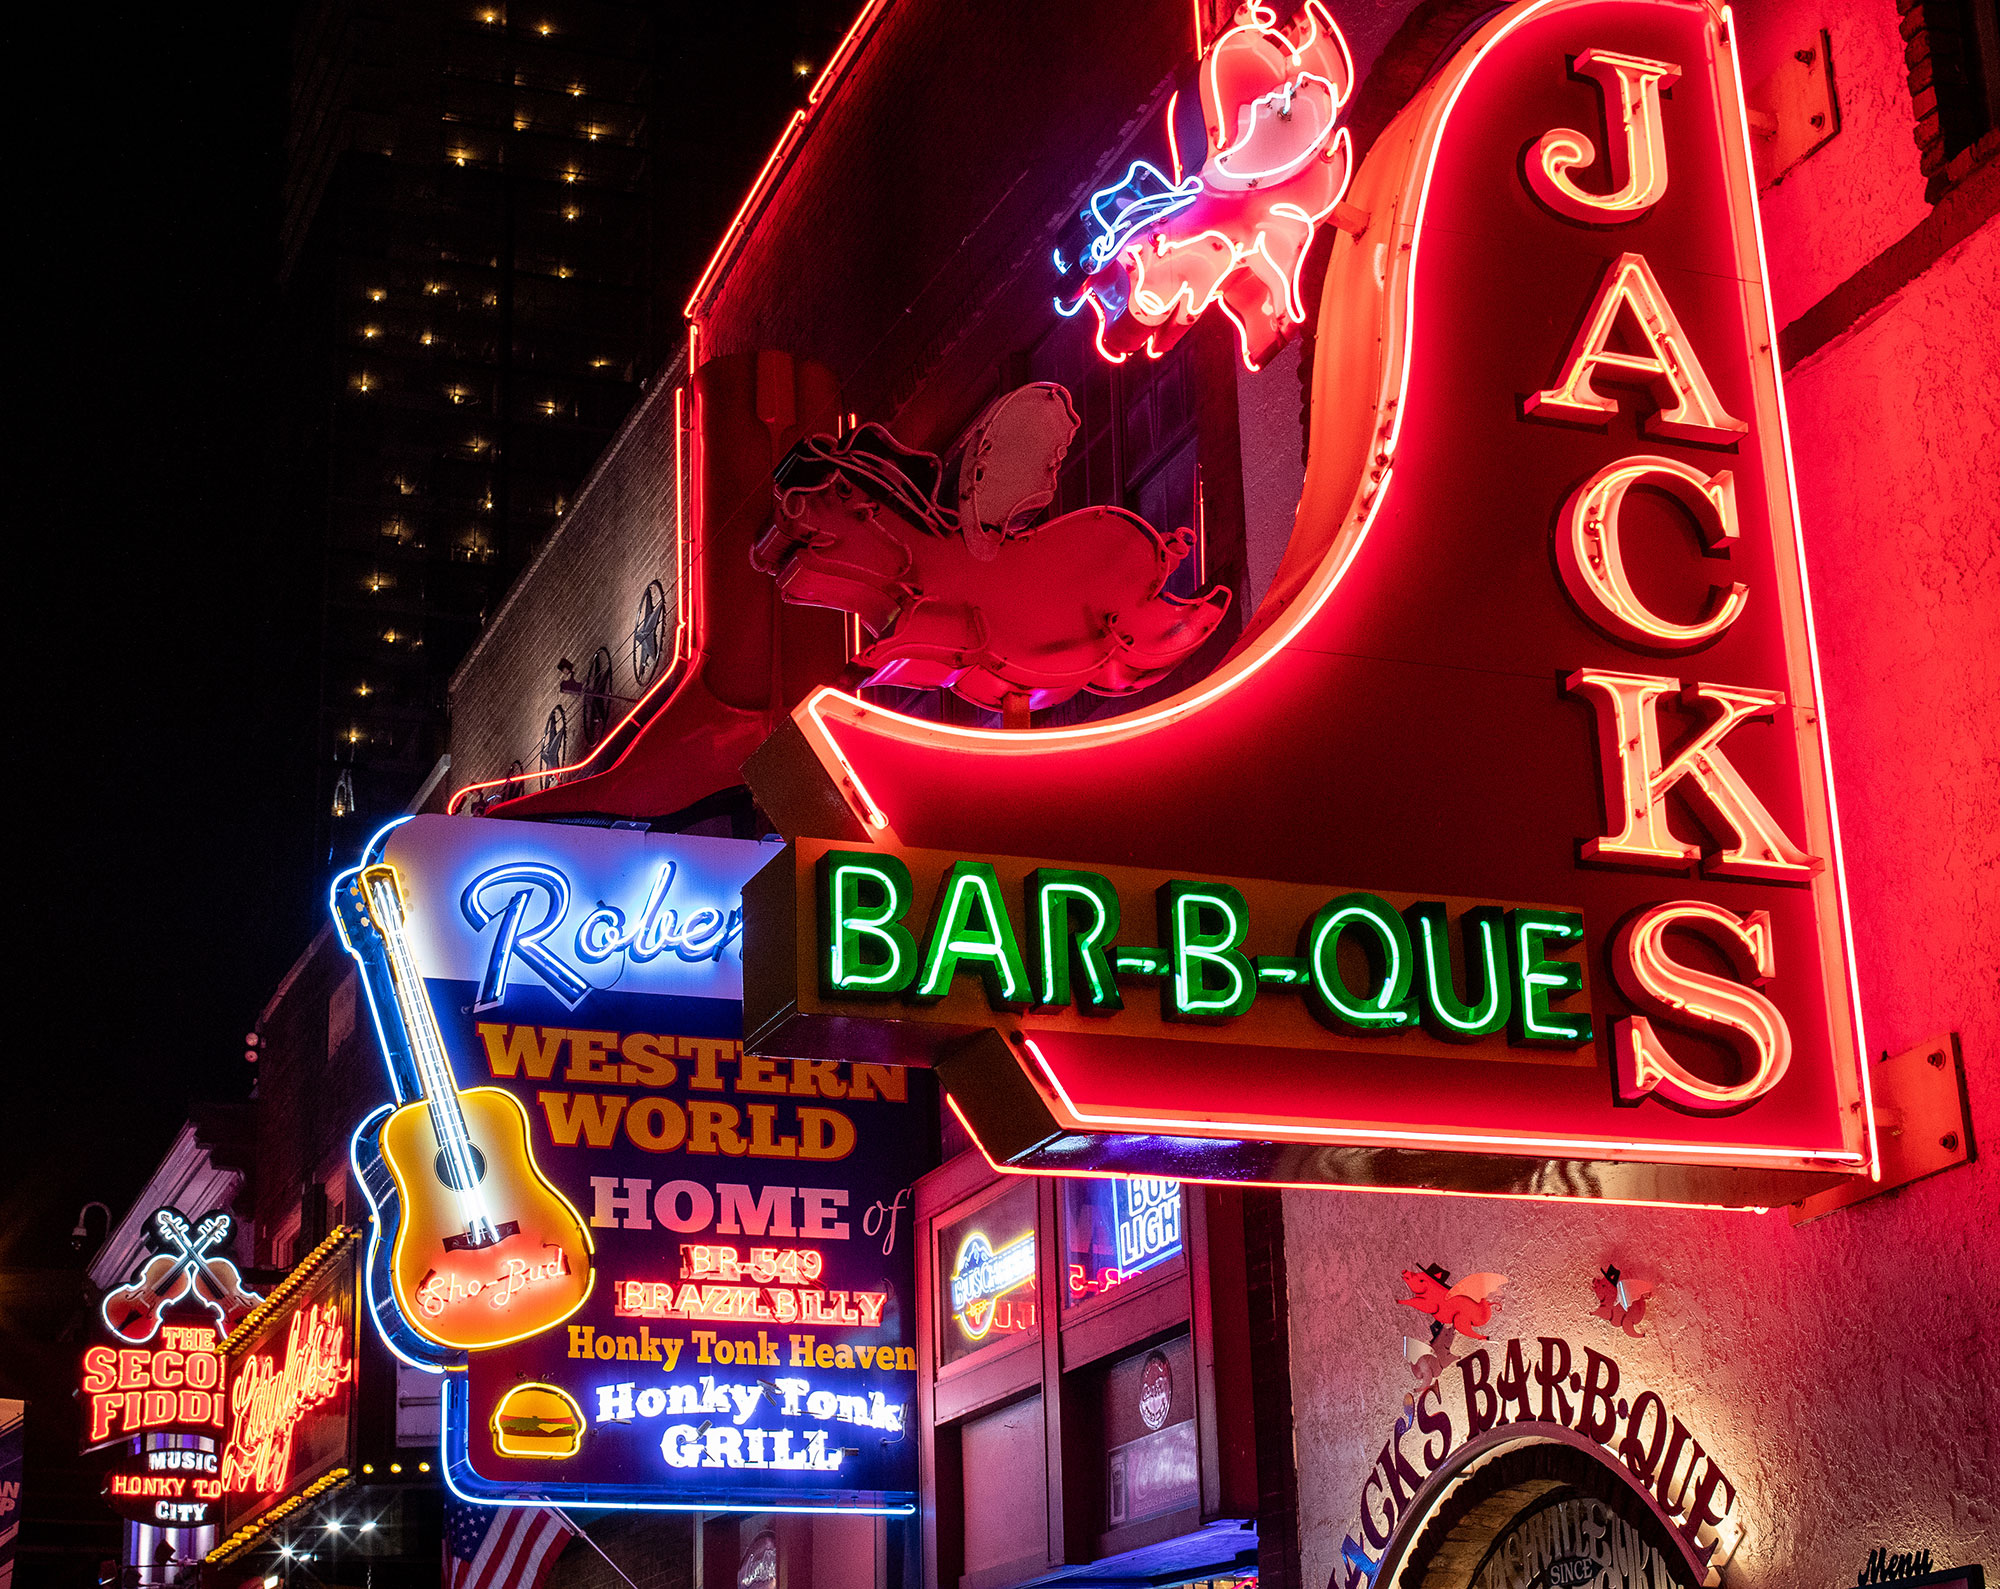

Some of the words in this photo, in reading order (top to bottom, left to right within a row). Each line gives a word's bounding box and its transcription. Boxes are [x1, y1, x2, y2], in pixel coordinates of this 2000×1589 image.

[1522, 46, 1828, 1112] JACKS
[460, 860, 744, 1012] Robe
[817, 847, 1596, 1050] BAR-B-QUE
[536, 1090, 858, 1162] WORLD
[589, 1175, 850, 1240] HOME
[862, 1188, 913, 1256] of
[420, 1246, 568, 1318] Sho-Bud
[680, 1244, 824, 1285] BR-549
[162, 1326, 216, 1351] THE
[567, 1325, 684, 1373] Honky
[691, 1330, 781, 1367] Tonk
[788, 1334, 917, 1372] Heaven
[83, 1345, 226, 1394] SECO
[594, 1375, 764, 1425] Honky
[774, 1377, 904, 1432] Tonk
[148, 1451, 218, 1474] MUSIC
[659, 1423, 842, 1471] GRILL
[112, 1475, 187, 1498] HONKY
[1326, 1378, 1453, 1589] ACK'S
[155, 1500, 209, 1522] CITY
[1550, 1558, 1593, 1586] SINCE
[1857, 1547, 1934, 1587] Menu
